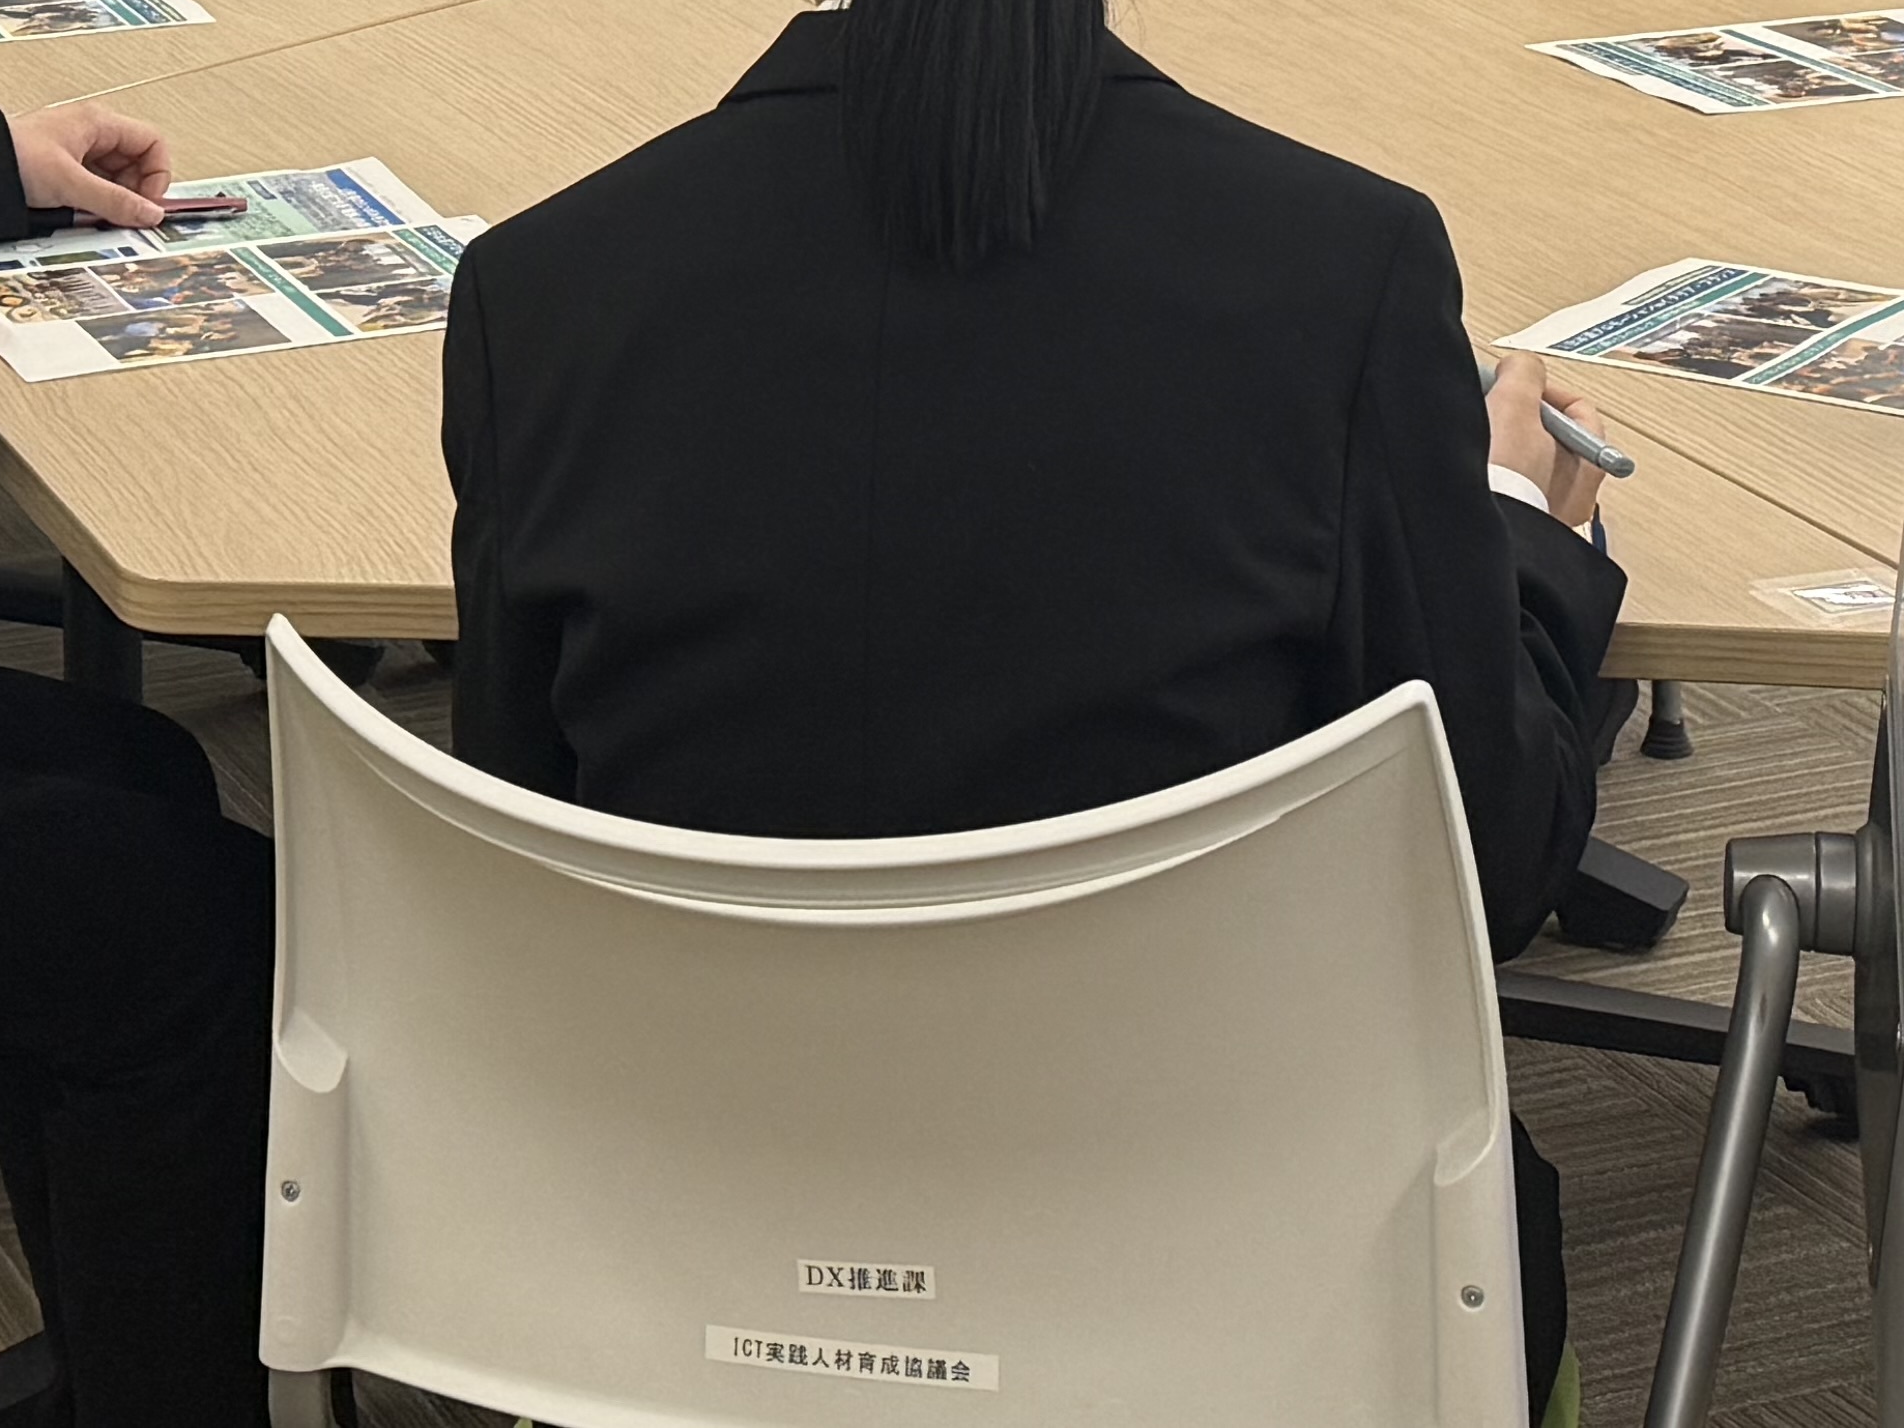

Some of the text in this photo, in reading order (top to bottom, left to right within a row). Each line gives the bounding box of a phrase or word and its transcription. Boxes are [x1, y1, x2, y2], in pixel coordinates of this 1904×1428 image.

[806, 1265, 927, 1294] DX推進課
[733, 1337, 970, 1382] ICT実践人材育成協議会
